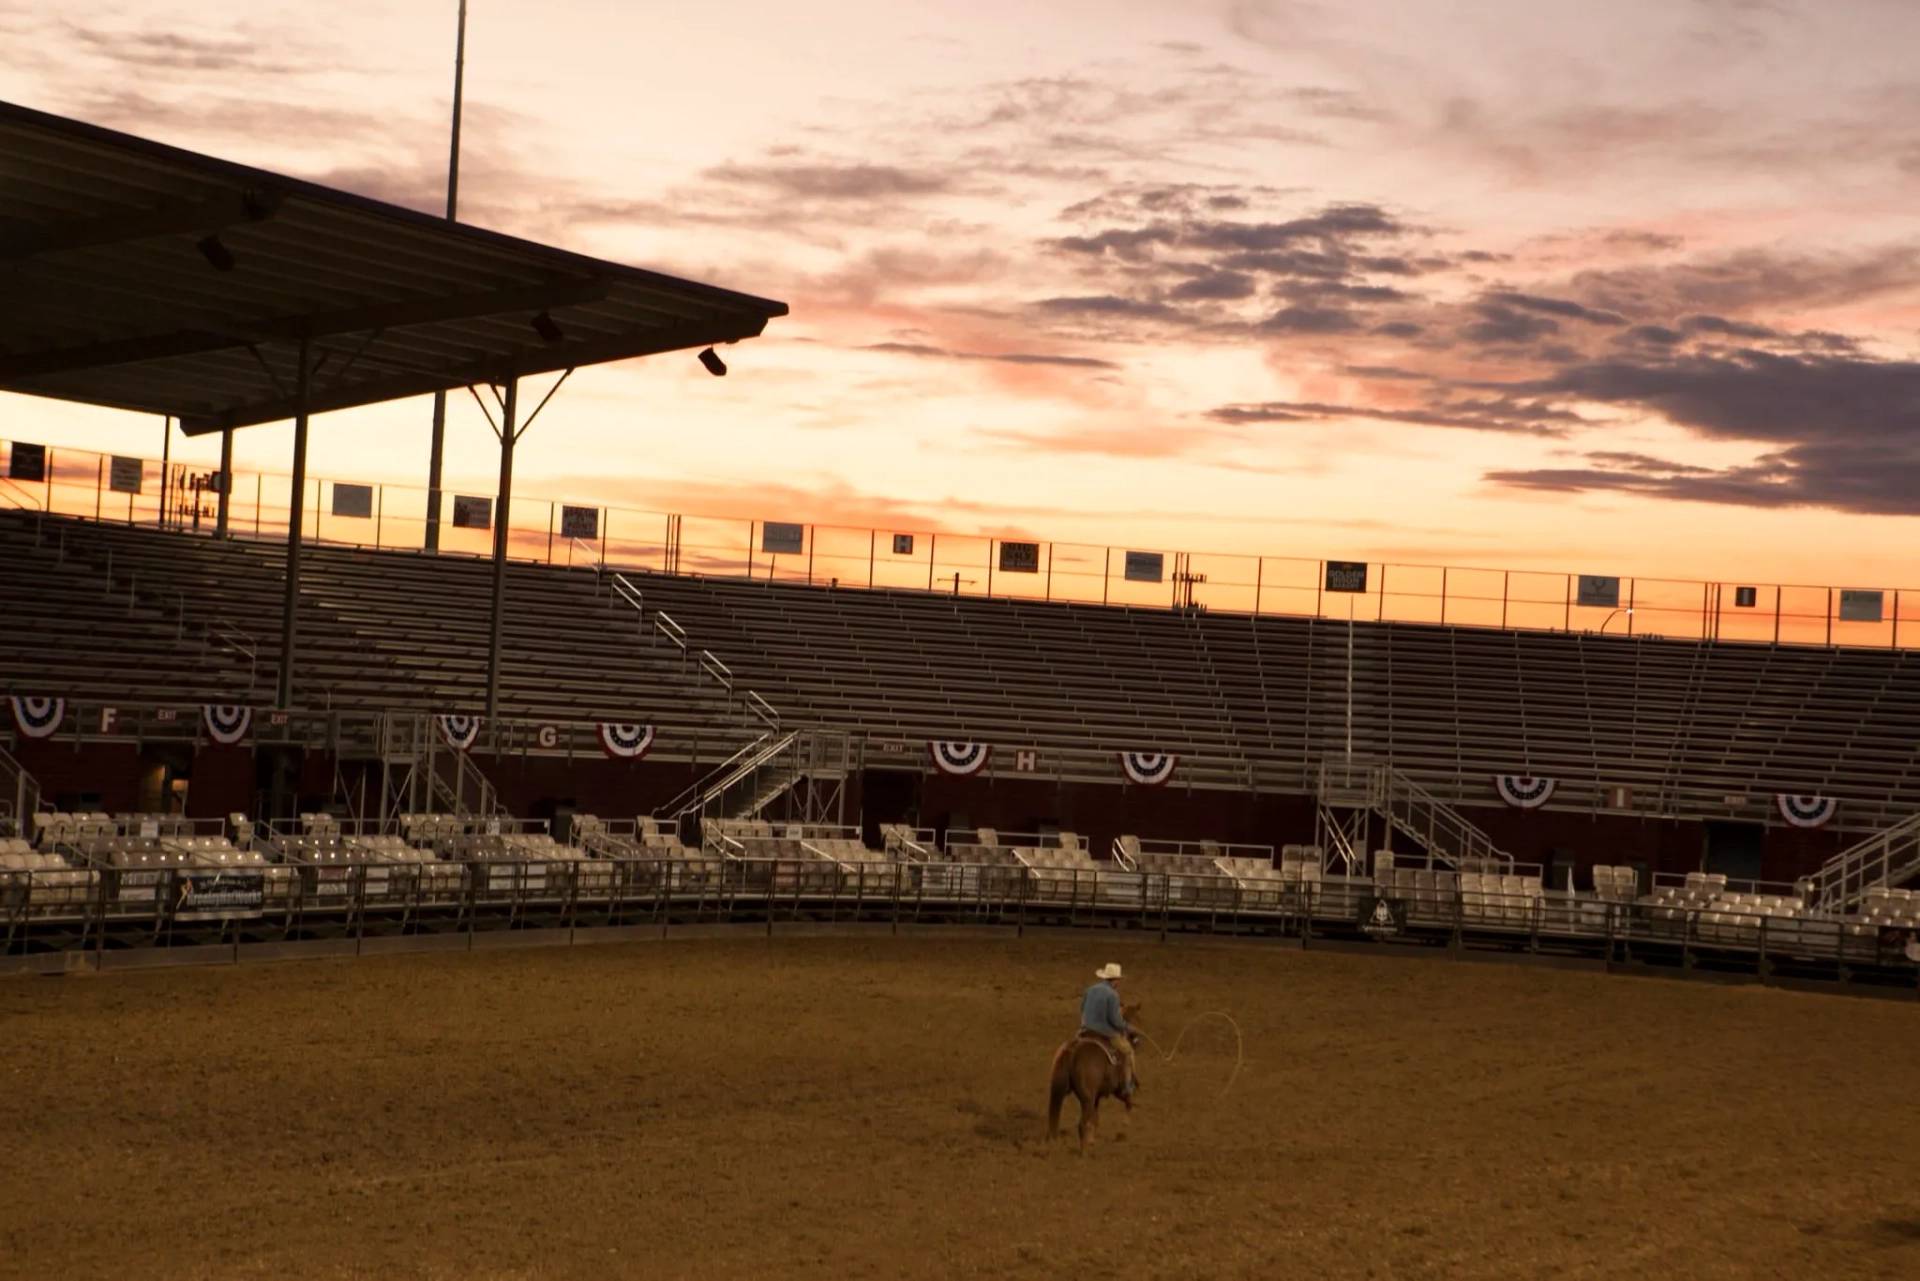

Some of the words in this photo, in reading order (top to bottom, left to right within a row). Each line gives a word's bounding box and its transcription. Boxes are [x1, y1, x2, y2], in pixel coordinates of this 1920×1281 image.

[895, 535, 911, 553] H
[102, 708, 117, 732] F
[158, 709, 177, 721] EXIT
[271, 713, 289, 725] EXIT
[540, 726, 557, 747] G
[883, 743, 904, 752] EXIT
[1017, 751, 1036, 771] H
